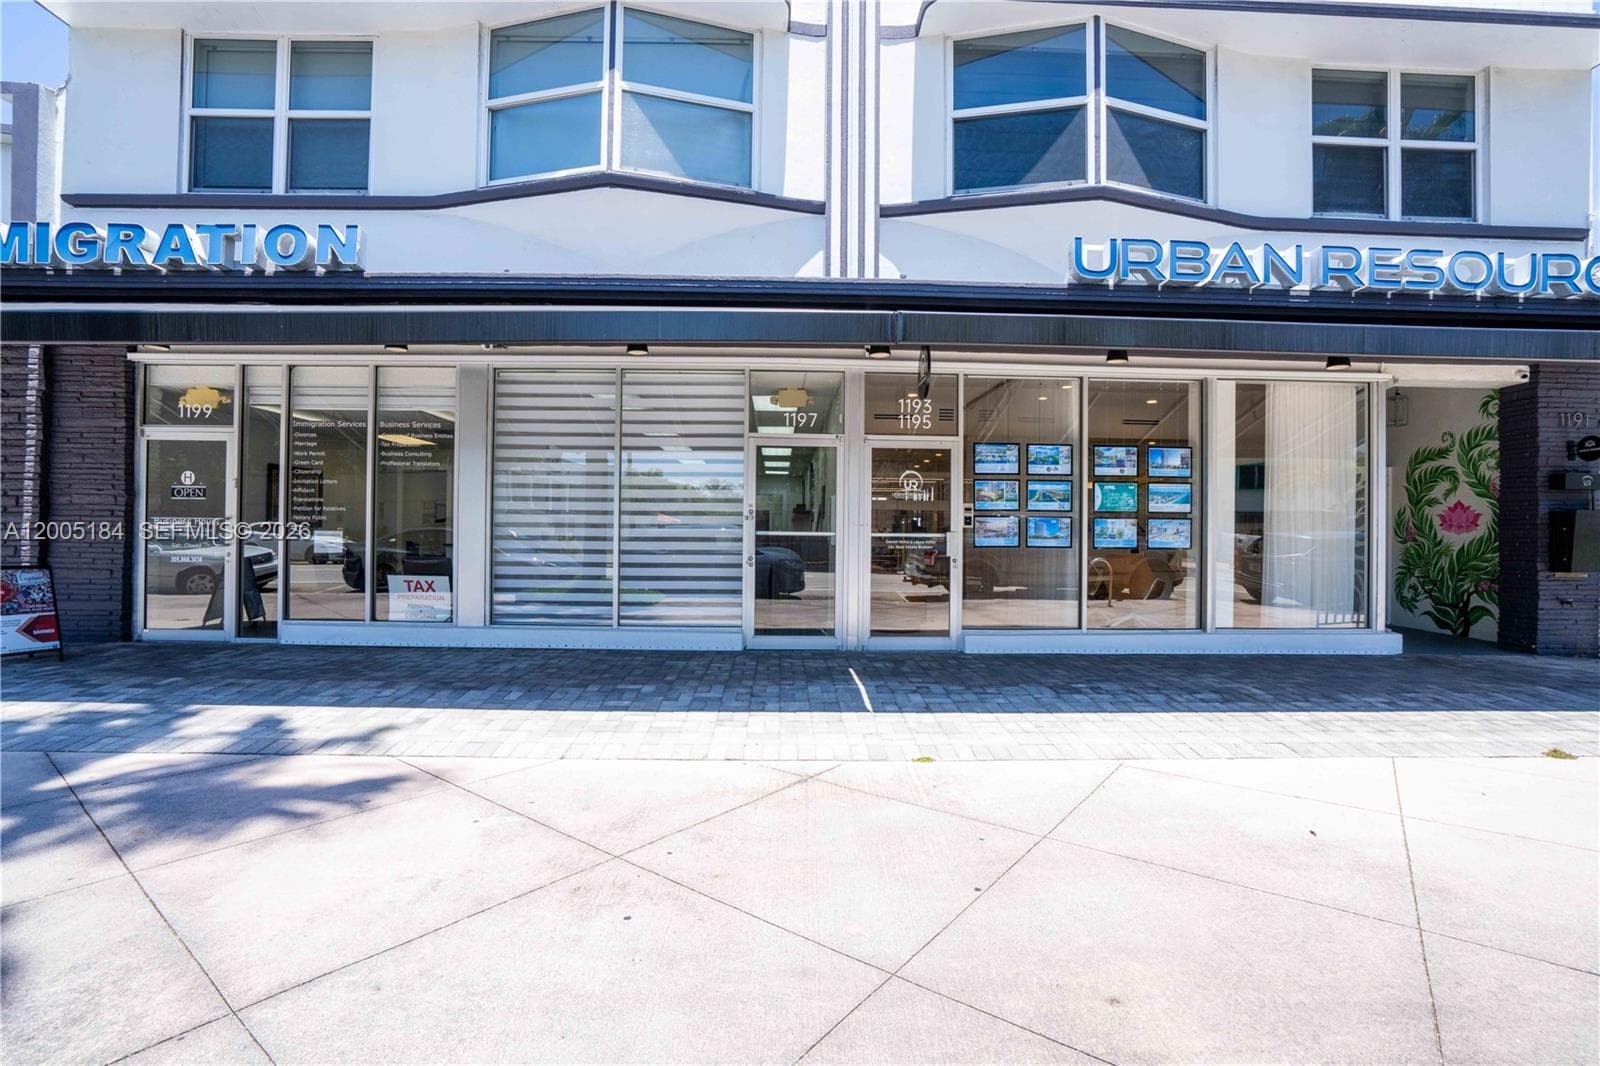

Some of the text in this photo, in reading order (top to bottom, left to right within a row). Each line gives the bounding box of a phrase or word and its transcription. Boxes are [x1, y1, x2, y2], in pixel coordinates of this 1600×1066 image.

[1073, 236, 1304, 288] URBAN
[178, 403, 212, 418] 1199
[898, 398, 932, 414] 1193
[783, 412, 818, 427] 1197
[898, 414, 932, 429] 1195
[1560, 412, 1589, 427] 1191
[174, 488, 204, 497] OPEN
[403, 580, 436, 592] TAX
